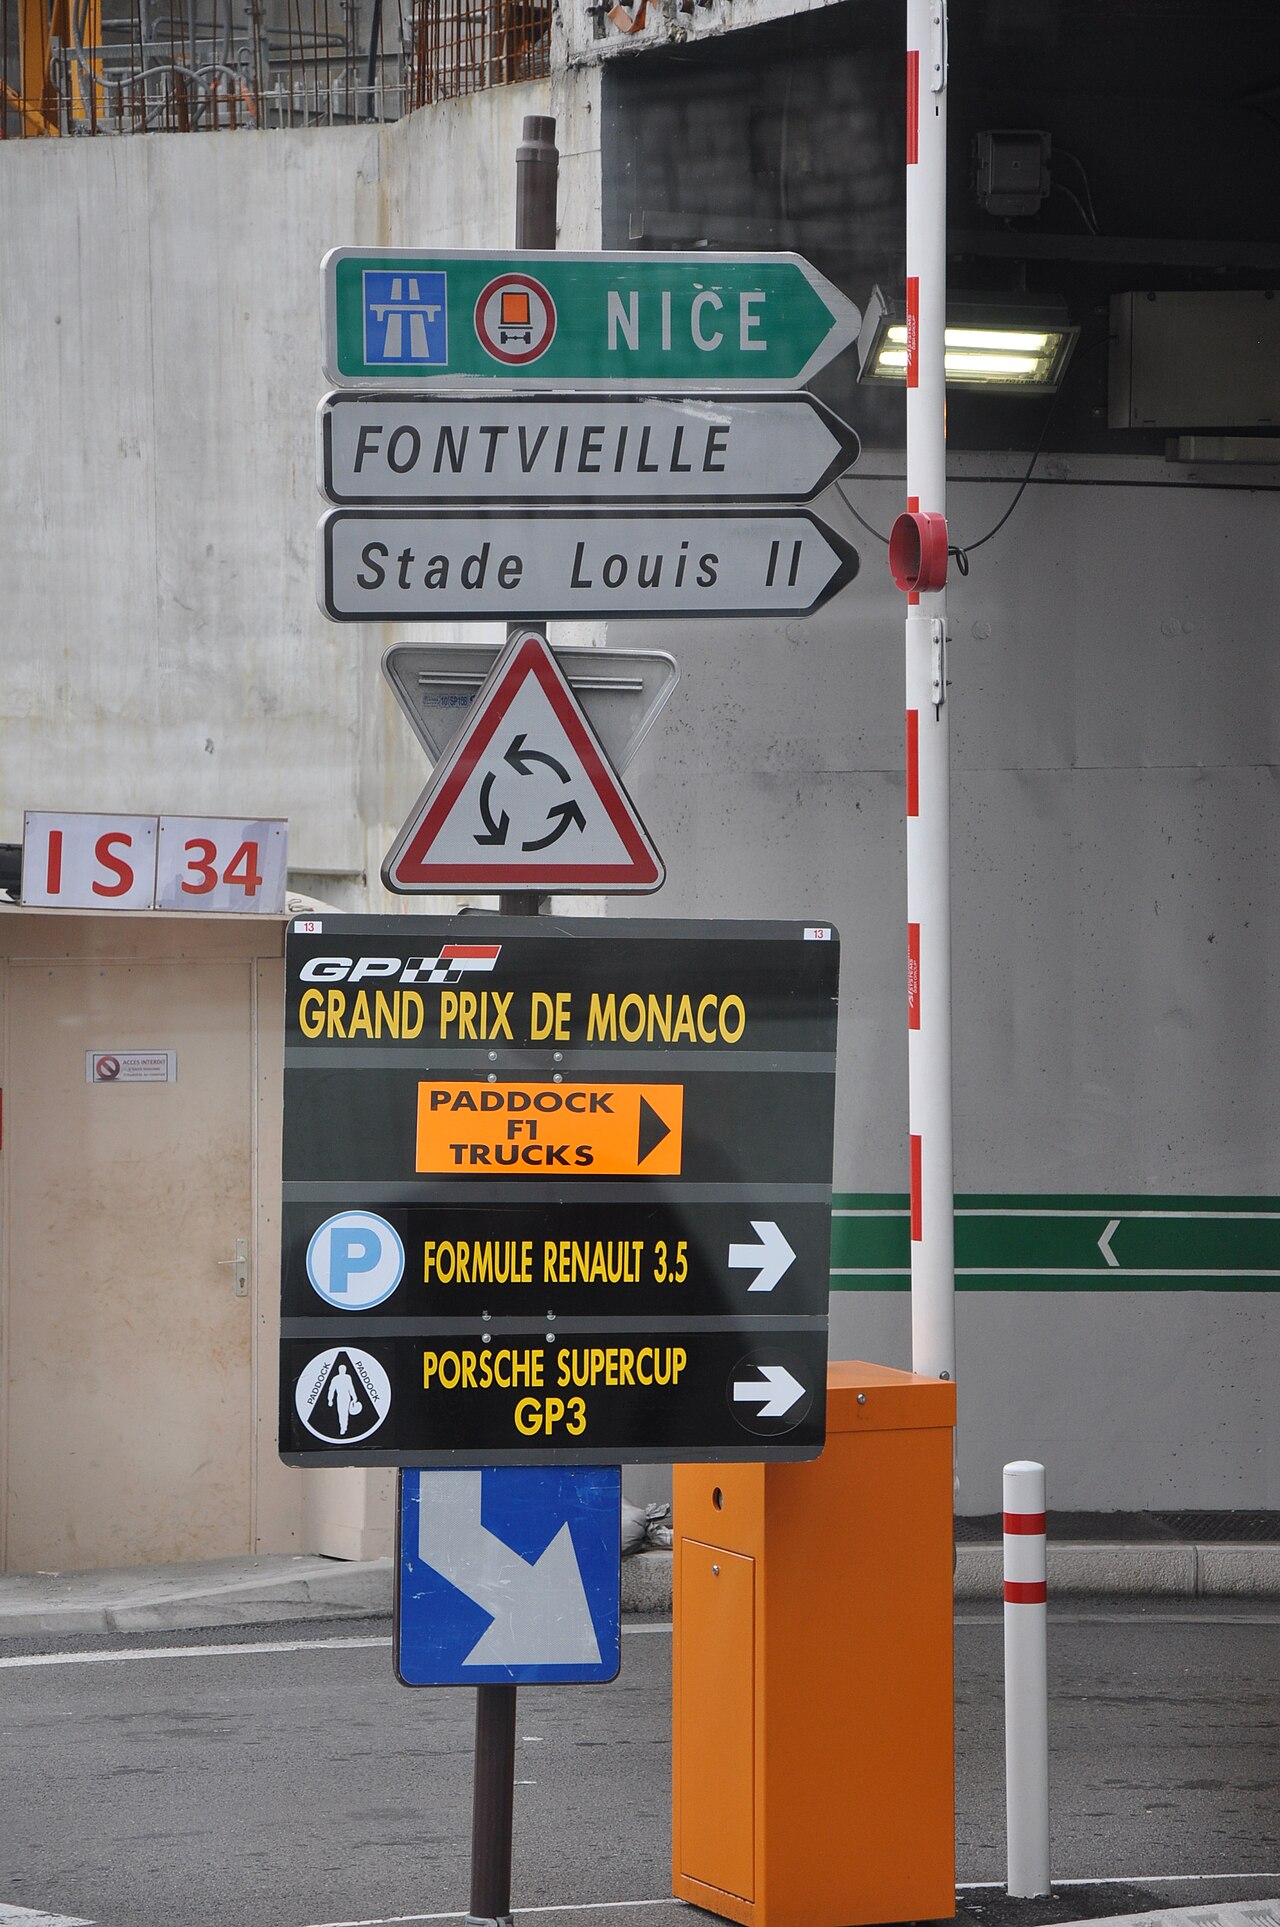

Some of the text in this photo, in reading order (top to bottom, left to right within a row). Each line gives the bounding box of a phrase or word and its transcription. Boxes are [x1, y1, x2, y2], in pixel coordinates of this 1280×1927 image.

[607, 289, 768, 353] NICE
[353, 425, 731, 475] FONTVIEILLE
[356, 540, 804, 591] Stade Louis II
[181, 838, 264, 897] 34
[303, 922, 315, 932] 13
[813, 929, 824, 939] 13
[300, 957, 402, 984] GP
[299, 988, 748, 1045] GRAND PRIX DE MONACO
[430, 1090, 616, 1115] PADDOCK
[506, 1119, 538, 1141] F1
[449, 1144, 595, 1168] TRUCKS
[423, 1240, 689, 1284] FORMULE RENAULT 3.5
[307, 1362, 331, 1405] PADDOCK
[355, 1361, 380, 1403] PADDOCK
[423, 1347, 688, 1390] PORSCHE SUPERCUP
[514, 1397, 588, 1437] GP3
